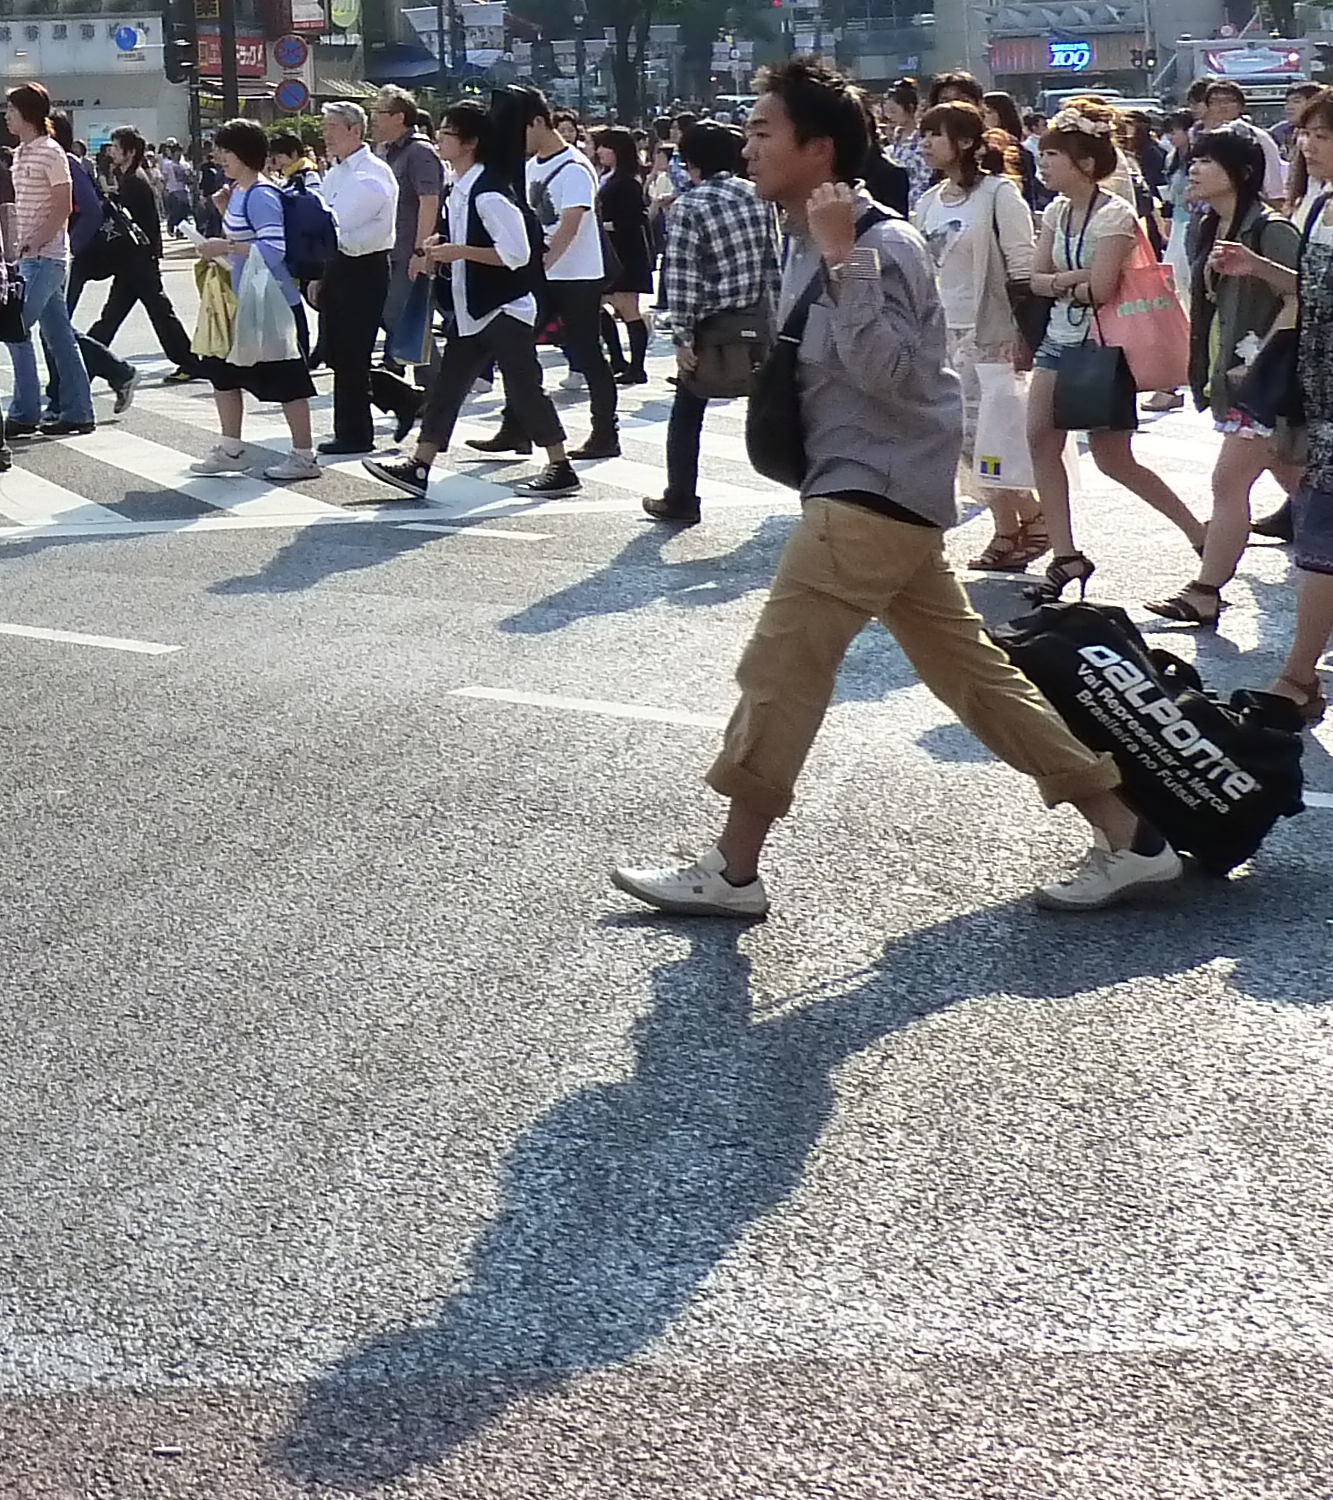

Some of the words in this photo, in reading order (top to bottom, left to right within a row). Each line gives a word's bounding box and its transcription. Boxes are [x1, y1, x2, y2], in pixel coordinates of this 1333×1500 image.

[1049, 51, 1090, 71] 109
[1076, 690, 1138, 753] Brasileira
[1136, 750, 1157, 771] no
[1099, 687, 1181, 767] Representar
[1188, 775, 1230, 815] Marca
